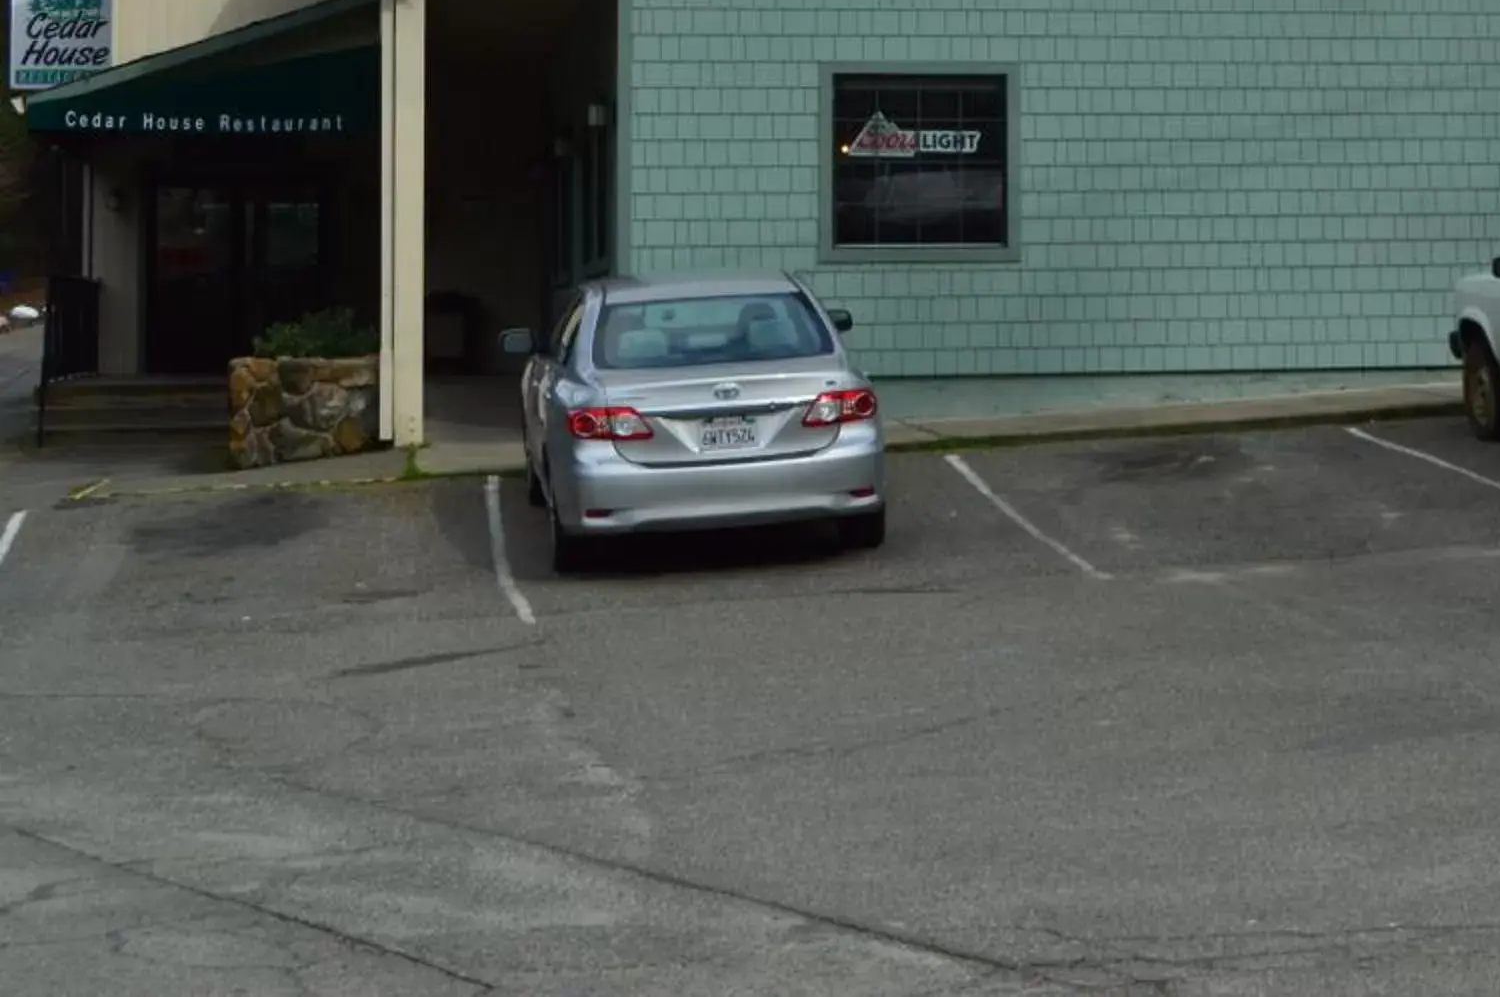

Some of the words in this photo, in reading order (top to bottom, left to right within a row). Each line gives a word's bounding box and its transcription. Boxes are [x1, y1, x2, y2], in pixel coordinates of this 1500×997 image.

[26, 10, 109, 40] Cedar
[20, 39, 110, 66] House
[64, 110, 127, 128] Cedar
[143, 113, 205, 131] House
[219, 114, 344, 132] Restaurant
[922, 133, 977, 150] LIGHT
